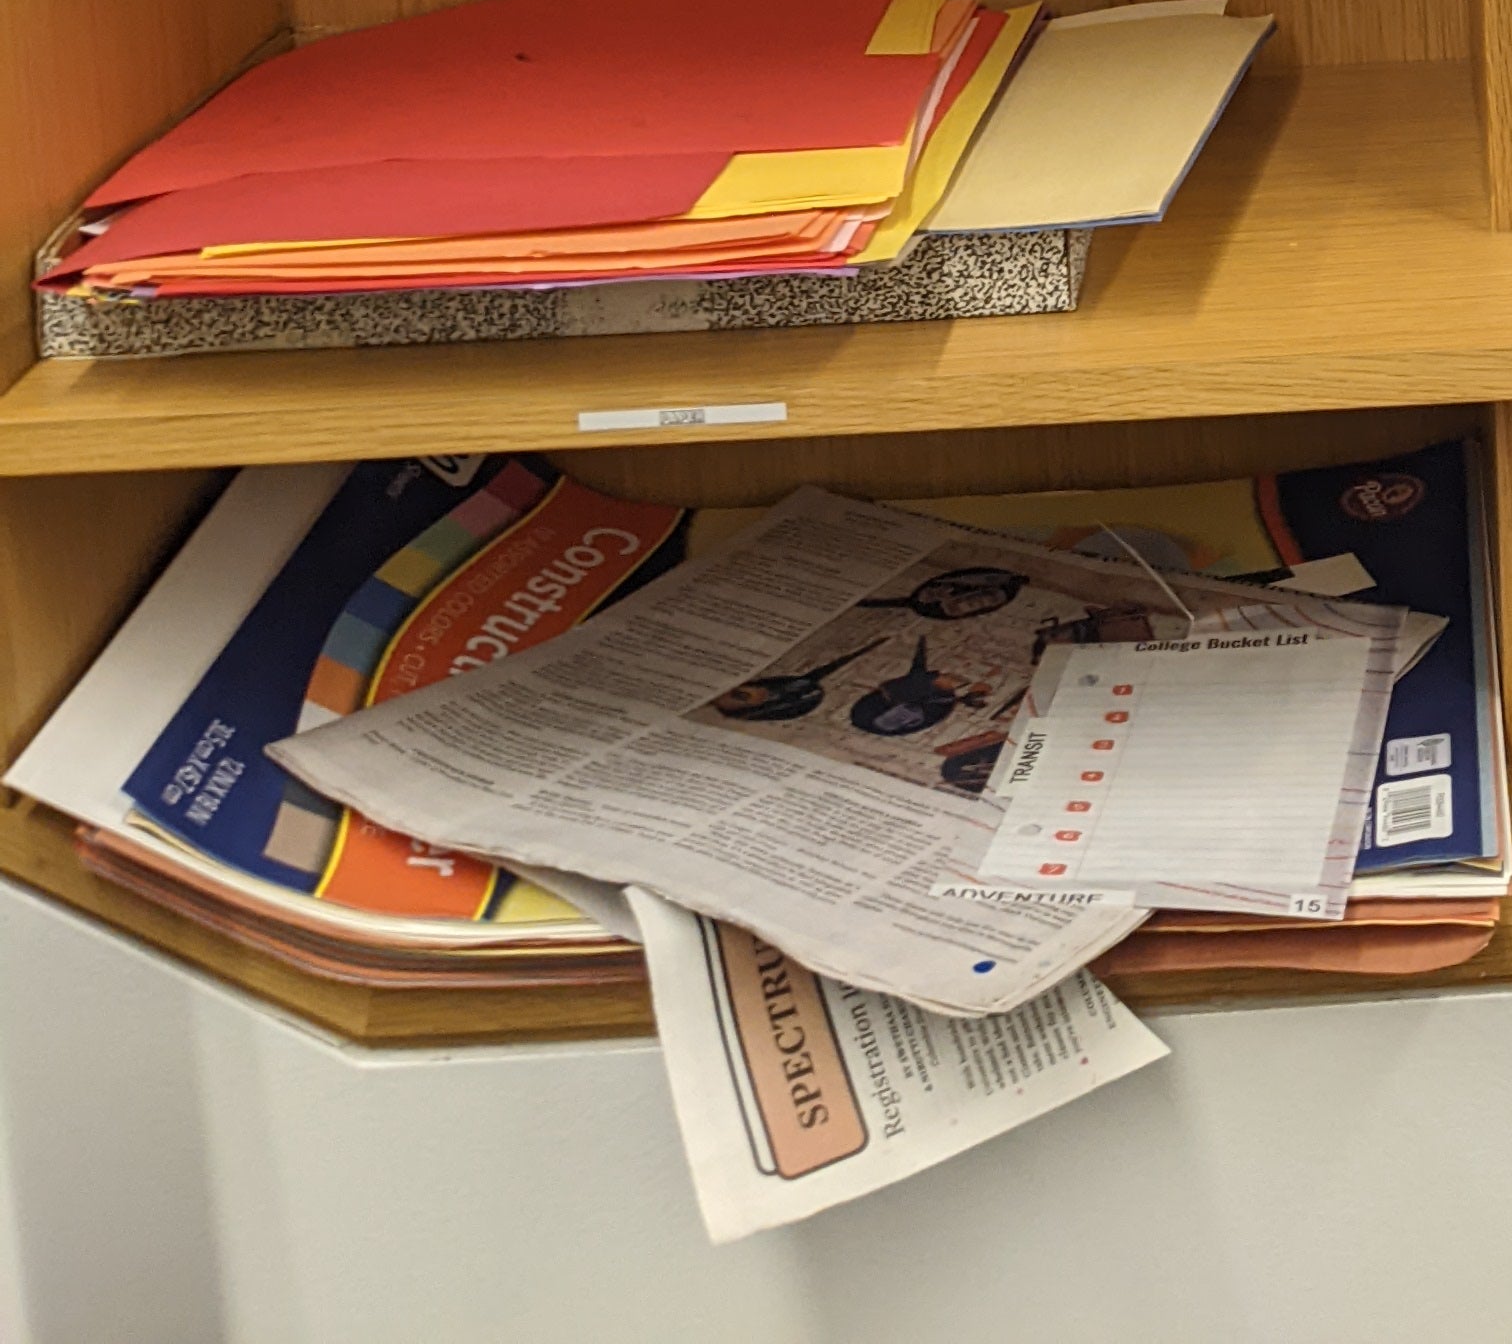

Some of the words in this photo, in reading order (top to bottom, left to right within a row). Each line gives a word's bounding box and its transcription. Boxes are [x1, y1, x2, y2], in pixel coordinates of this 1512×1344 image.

[1135, 640, 1201, 653] College
[1207, 636, 1270, 649] Bucket
[1276, 633, 1309, 646] List
[1009, 732, 1048, 785] TRANSIT
[1293, 899, 1321, 913] 15
[750, 932, 831, 1130] SPECTRU
[852, 1008, 905, 1141] Registration
